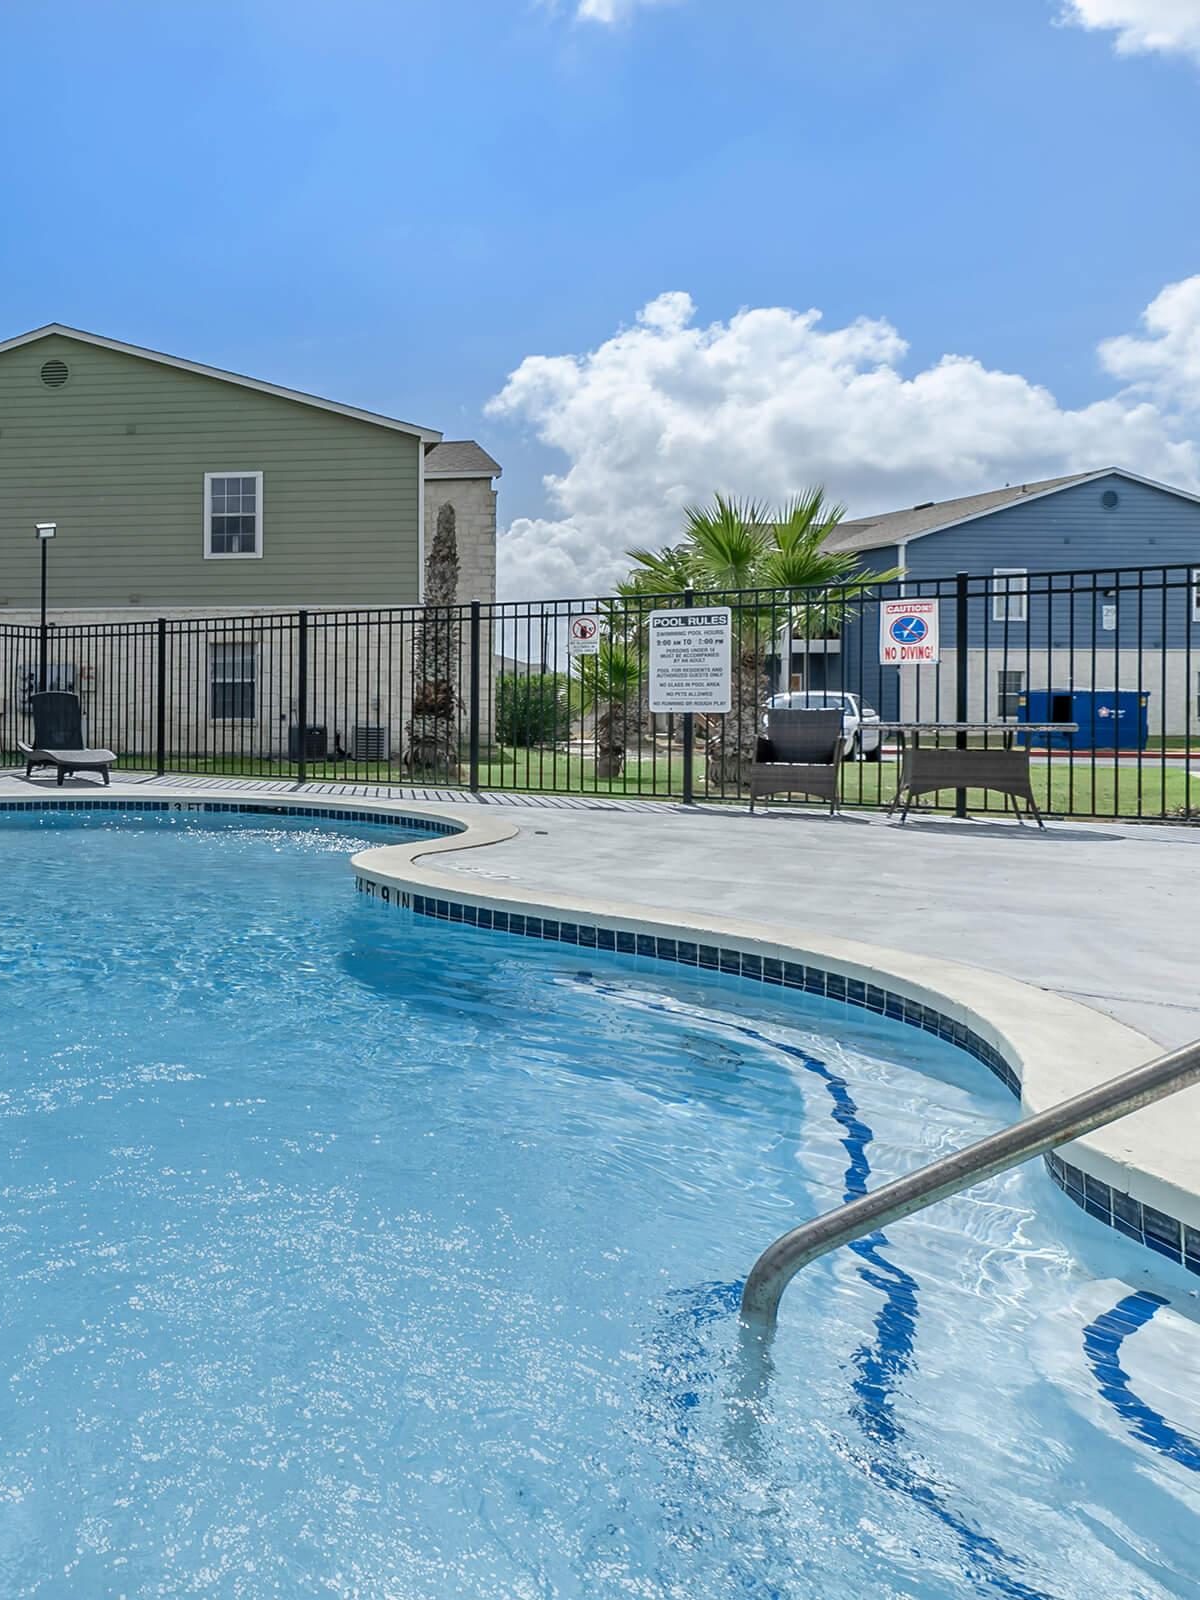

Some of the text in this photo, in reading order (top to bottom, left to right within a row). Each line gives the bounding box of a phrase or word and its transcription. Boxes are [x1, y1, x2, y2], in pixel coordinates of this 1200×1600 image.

[654, 616, 726, 627] POOL RULES
[885, 646, 933, 660] NO DIVING!
[188, 803, 202, 811] FT
[366, 880, 376, 896] FT
[397, 890, 410, 908] IN
